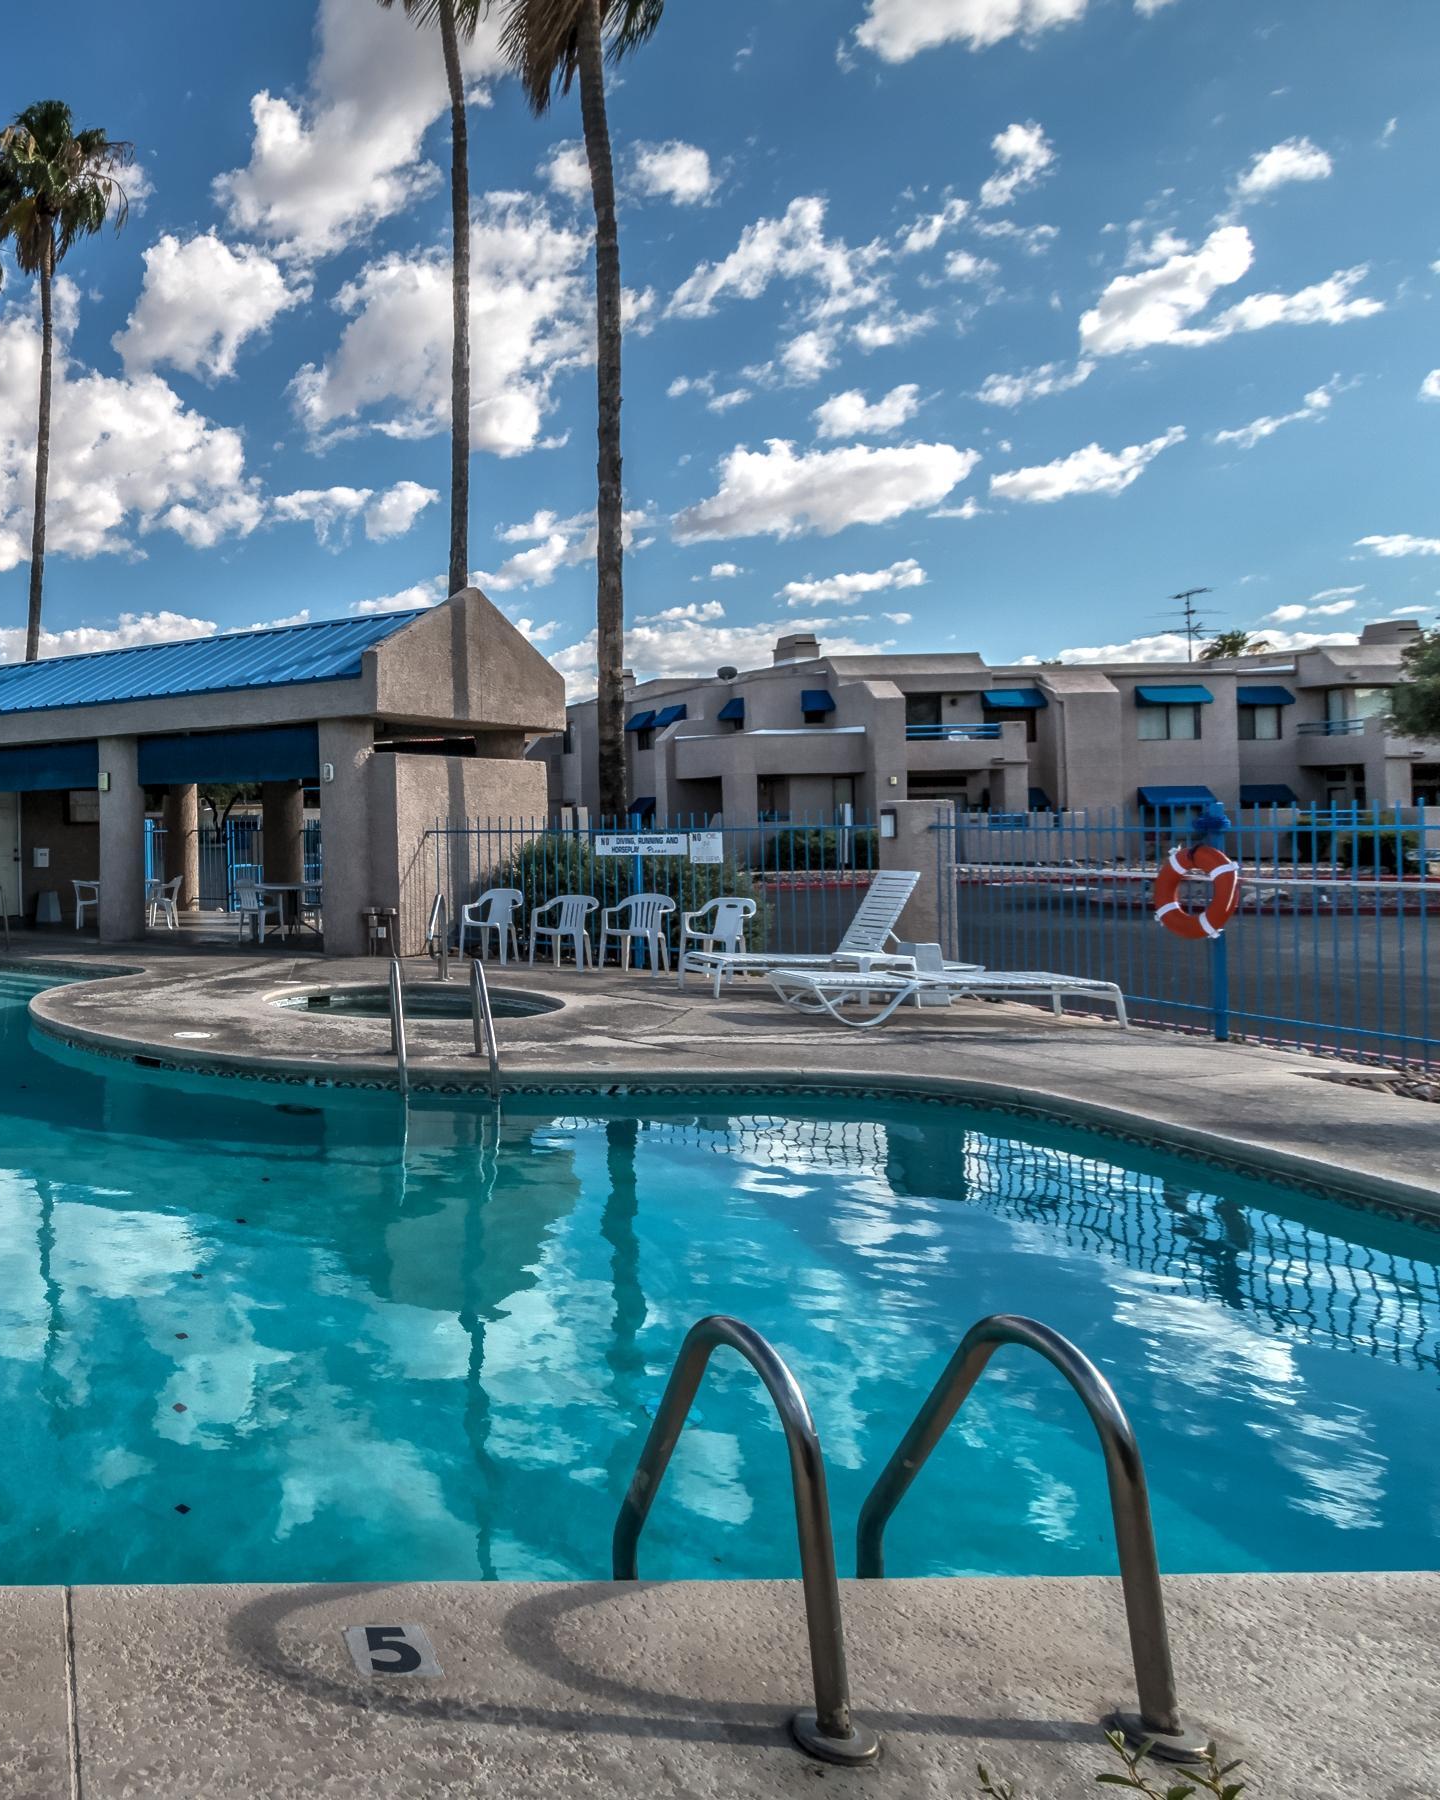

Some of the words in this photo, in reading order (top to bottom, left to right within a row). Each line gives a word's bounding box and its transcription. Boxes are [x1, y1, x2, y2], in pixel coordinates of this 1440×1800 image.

[601, 837, 610, 845] NO
[692, 833, 702, 841] NO
[364, 1626, 422, 1674] 5
